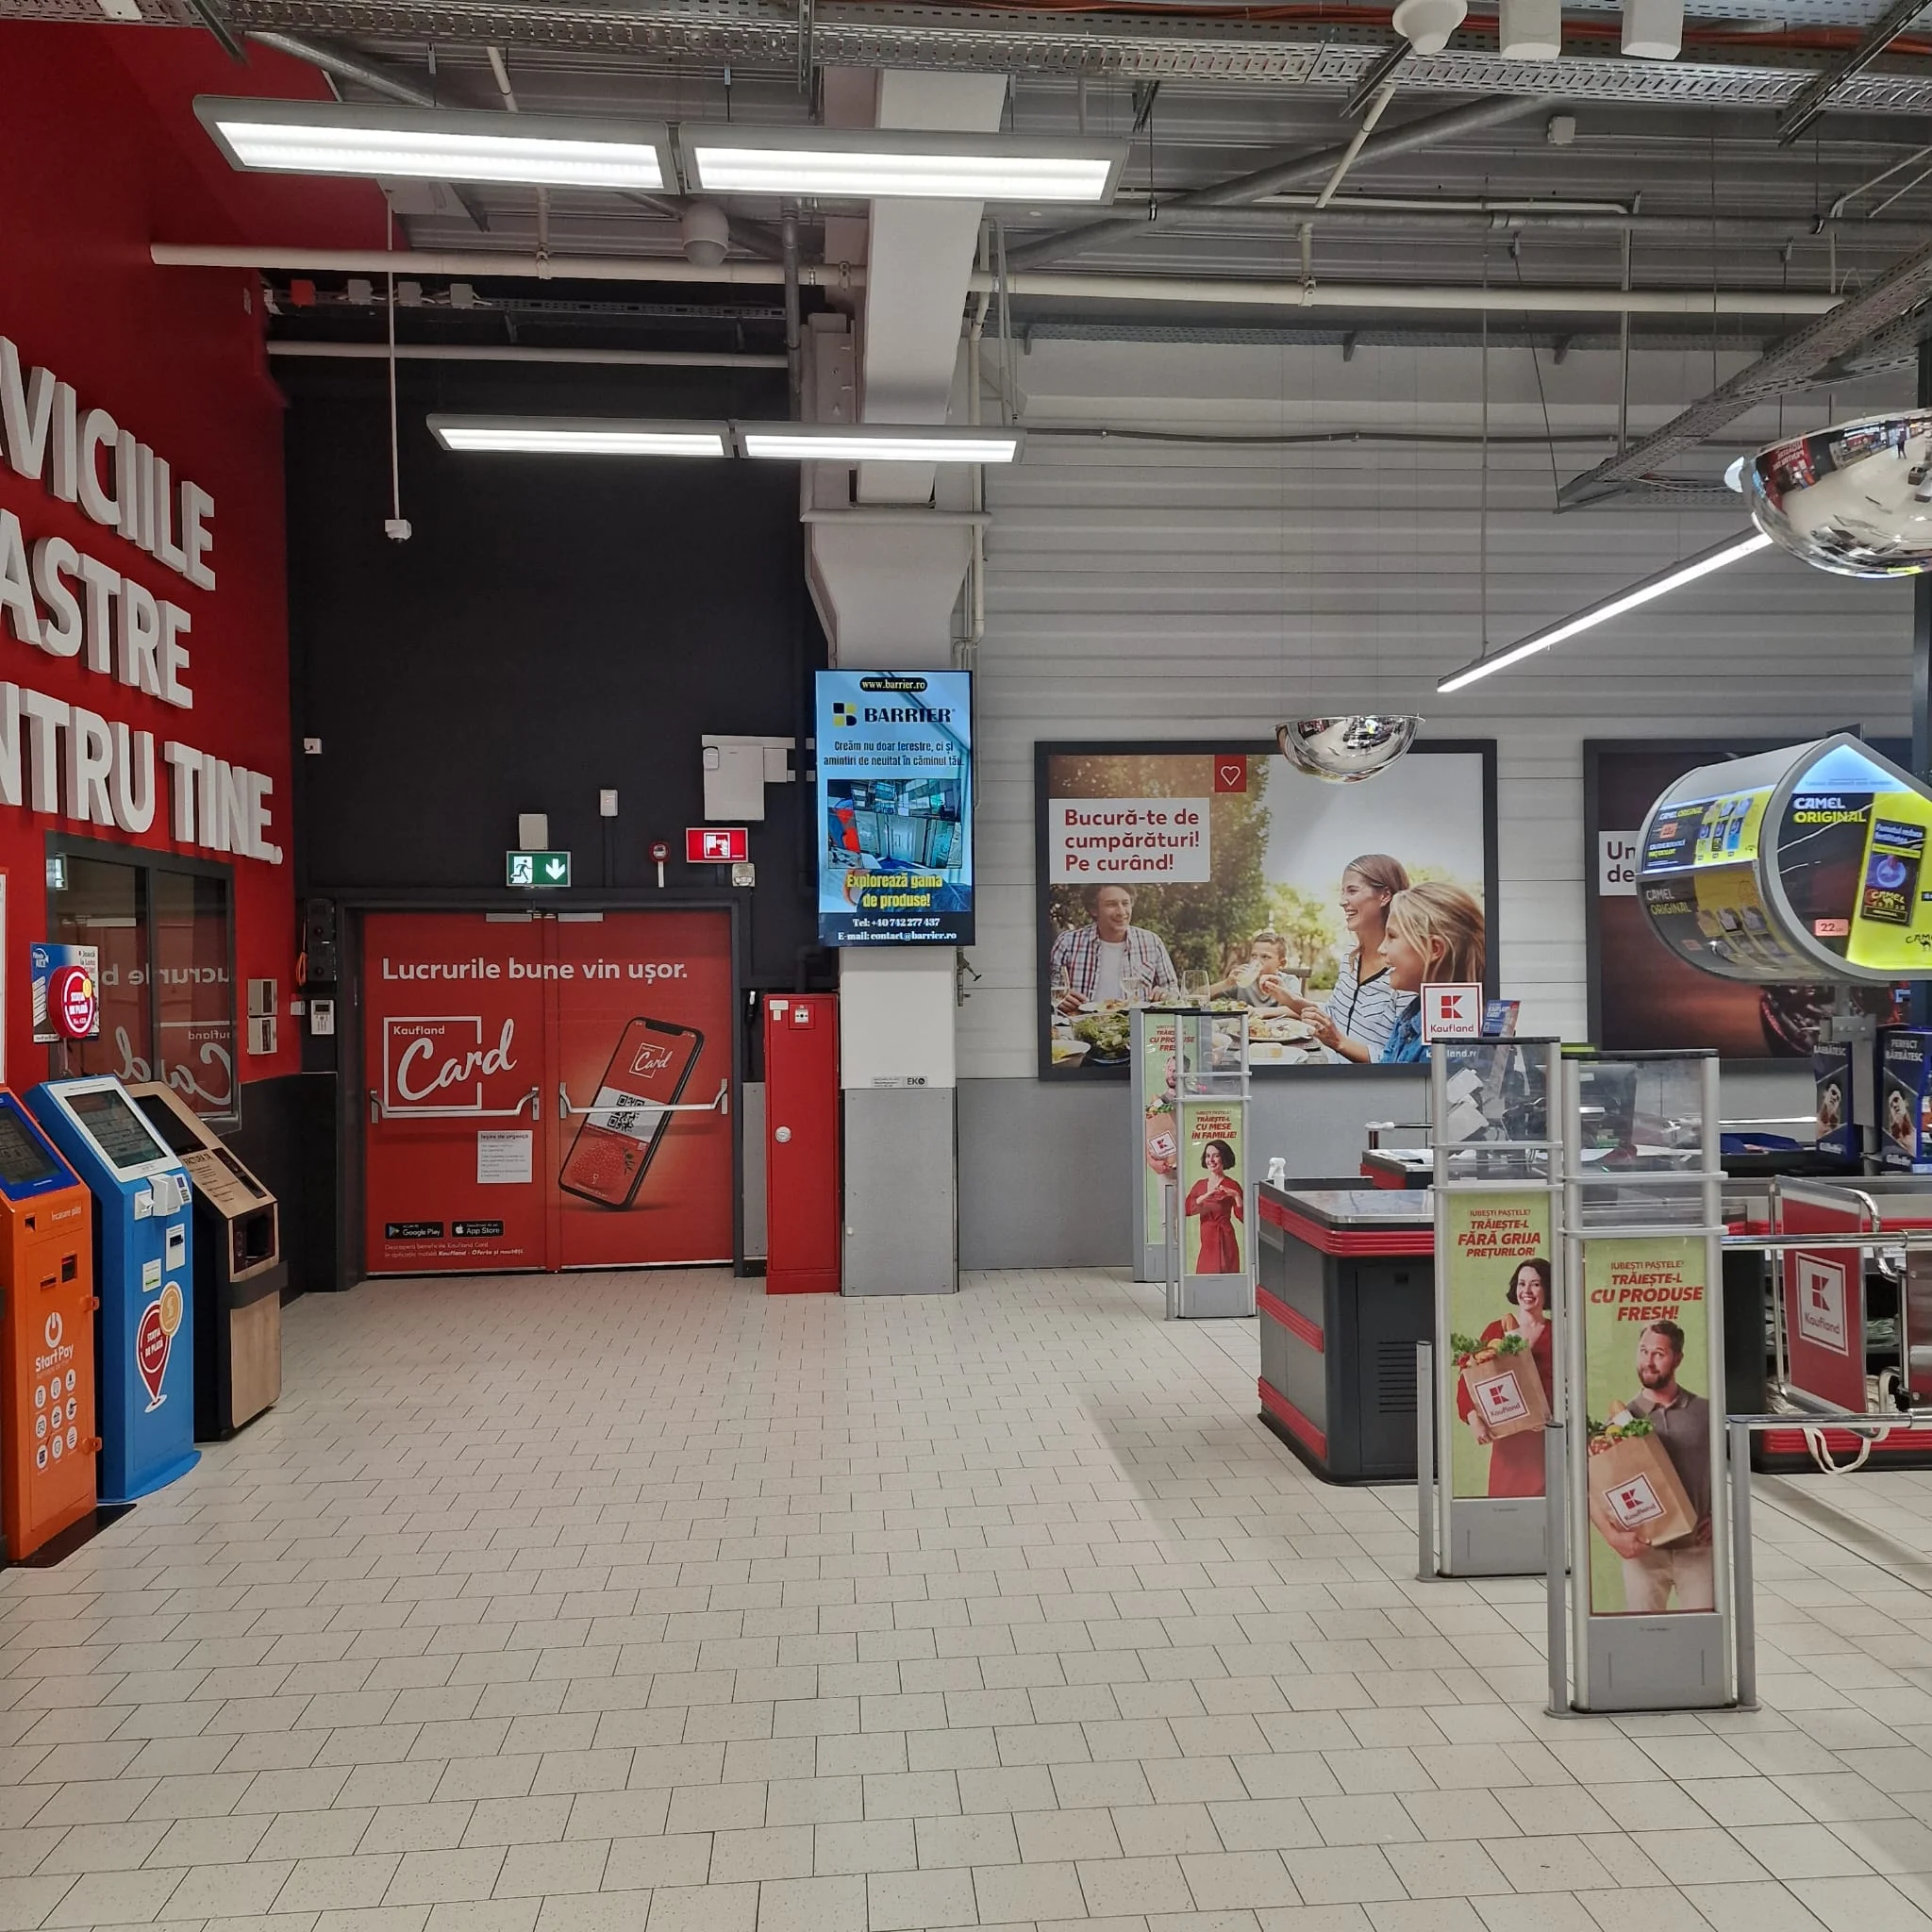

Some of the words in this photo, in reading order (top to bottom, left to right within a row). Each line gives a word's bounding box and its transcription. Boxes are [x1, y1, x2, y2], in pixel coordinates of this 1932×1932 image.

[0, 335, 215, 591] VICIILE
[0, 508, 192, 708] ASTRE
[862, 679, 925, 690] www.barrier.ro
[864, 708, 952, 723] BARRIER
[835, 741, 861, 752] Creăm
[876, 741, 895, 751] doar
[897, 741, 934, 753] ferestre,
[936, 741, 943, 751] ci
[945, 741, 954, 754] și
[824, 756, 857, 766] amintiri
[858, 756, 869, 766] de
[871, 756, 901, 766] neuitat
[903, 756, 910, 766] în
[912, 756, 947, 766] căminul
[164, 741, 282, 864] TINE.
[1793, 798, 1846, 809] CAMEL
[1064, 808, 1167, 826] Bucură-te
[1174, 808, 1199, 825] de
[1793, 810, 1867, 824] ORIGINAL
[1064, 830, 1199, 852] cumpărături!
[1064, 854, 1090, 872] Pe
[1096, 852, 1174, 872] curând!
[1607, 864, 1635, 882] de
[846, 873, 908, 890] Explorează
[910, 874, 942, 890] gama
[862, 892, 878, 908] de
[880, 891, 931, 910] produse!
[1646, 889, 1674, 901] CAMEL
[852, 918, 870, 928] Tel:
[871, 918, 888, 928] +40
[889, 918, 906, 928] 742
[906, 918, 922, 928] 277
[924, 918, 941, 928] 437
[1821, 924, 1836, 932] 22
[838, 931, 870, 941] E-mail:
[871, 930, 958, 941] contact@barrier.ro
[382, 958, 501, 980] Lucrurile
[508, 958, 575, 980] bune
[581, 958, 621, 979] vin
[628, 958, 688, 986] ușor.
[392, 1025, 445, 1036] Kaufland
[1430, 1023, 1474, 1034] Kaufland
[397, 1018, 518, 1102] Card
[634, 1051, 673, 1072] Card
[1191, 1130, 1202, 1140] ÎN
[1202, 1130, 1237, 1140] FAMILIE!
[1470, 1208, 1500, 1218] IUBEȘTI
[427, 1228, 441, 1237] Play
[1471, 1219, 1529, 1231] TRĂIEȘTE-L
[1457, 1230, 1497, 1245] FĂRĂ
[1501, 1233, 1541, 1245] GRIJA
[1466, 1246, 1536, 1259] PREȚURILOR!
[1610, 1260, 1642, 1271] IUBEȘTI
[1611, 1273, 1682, 1286] TRĂIEȘTE-L
[1591, 1288, 1616, 1304] CU
[1619, 1286, 1704, 1303] PRODUSE
[1617, 1306, 1678, 1322] FRESH!
[1804, 1312, 1840, 1335] Kaufland
[1490, 1402, 1521, 1417] Kaufland
[1624, 1503, 1657, 1522] Kaufland
